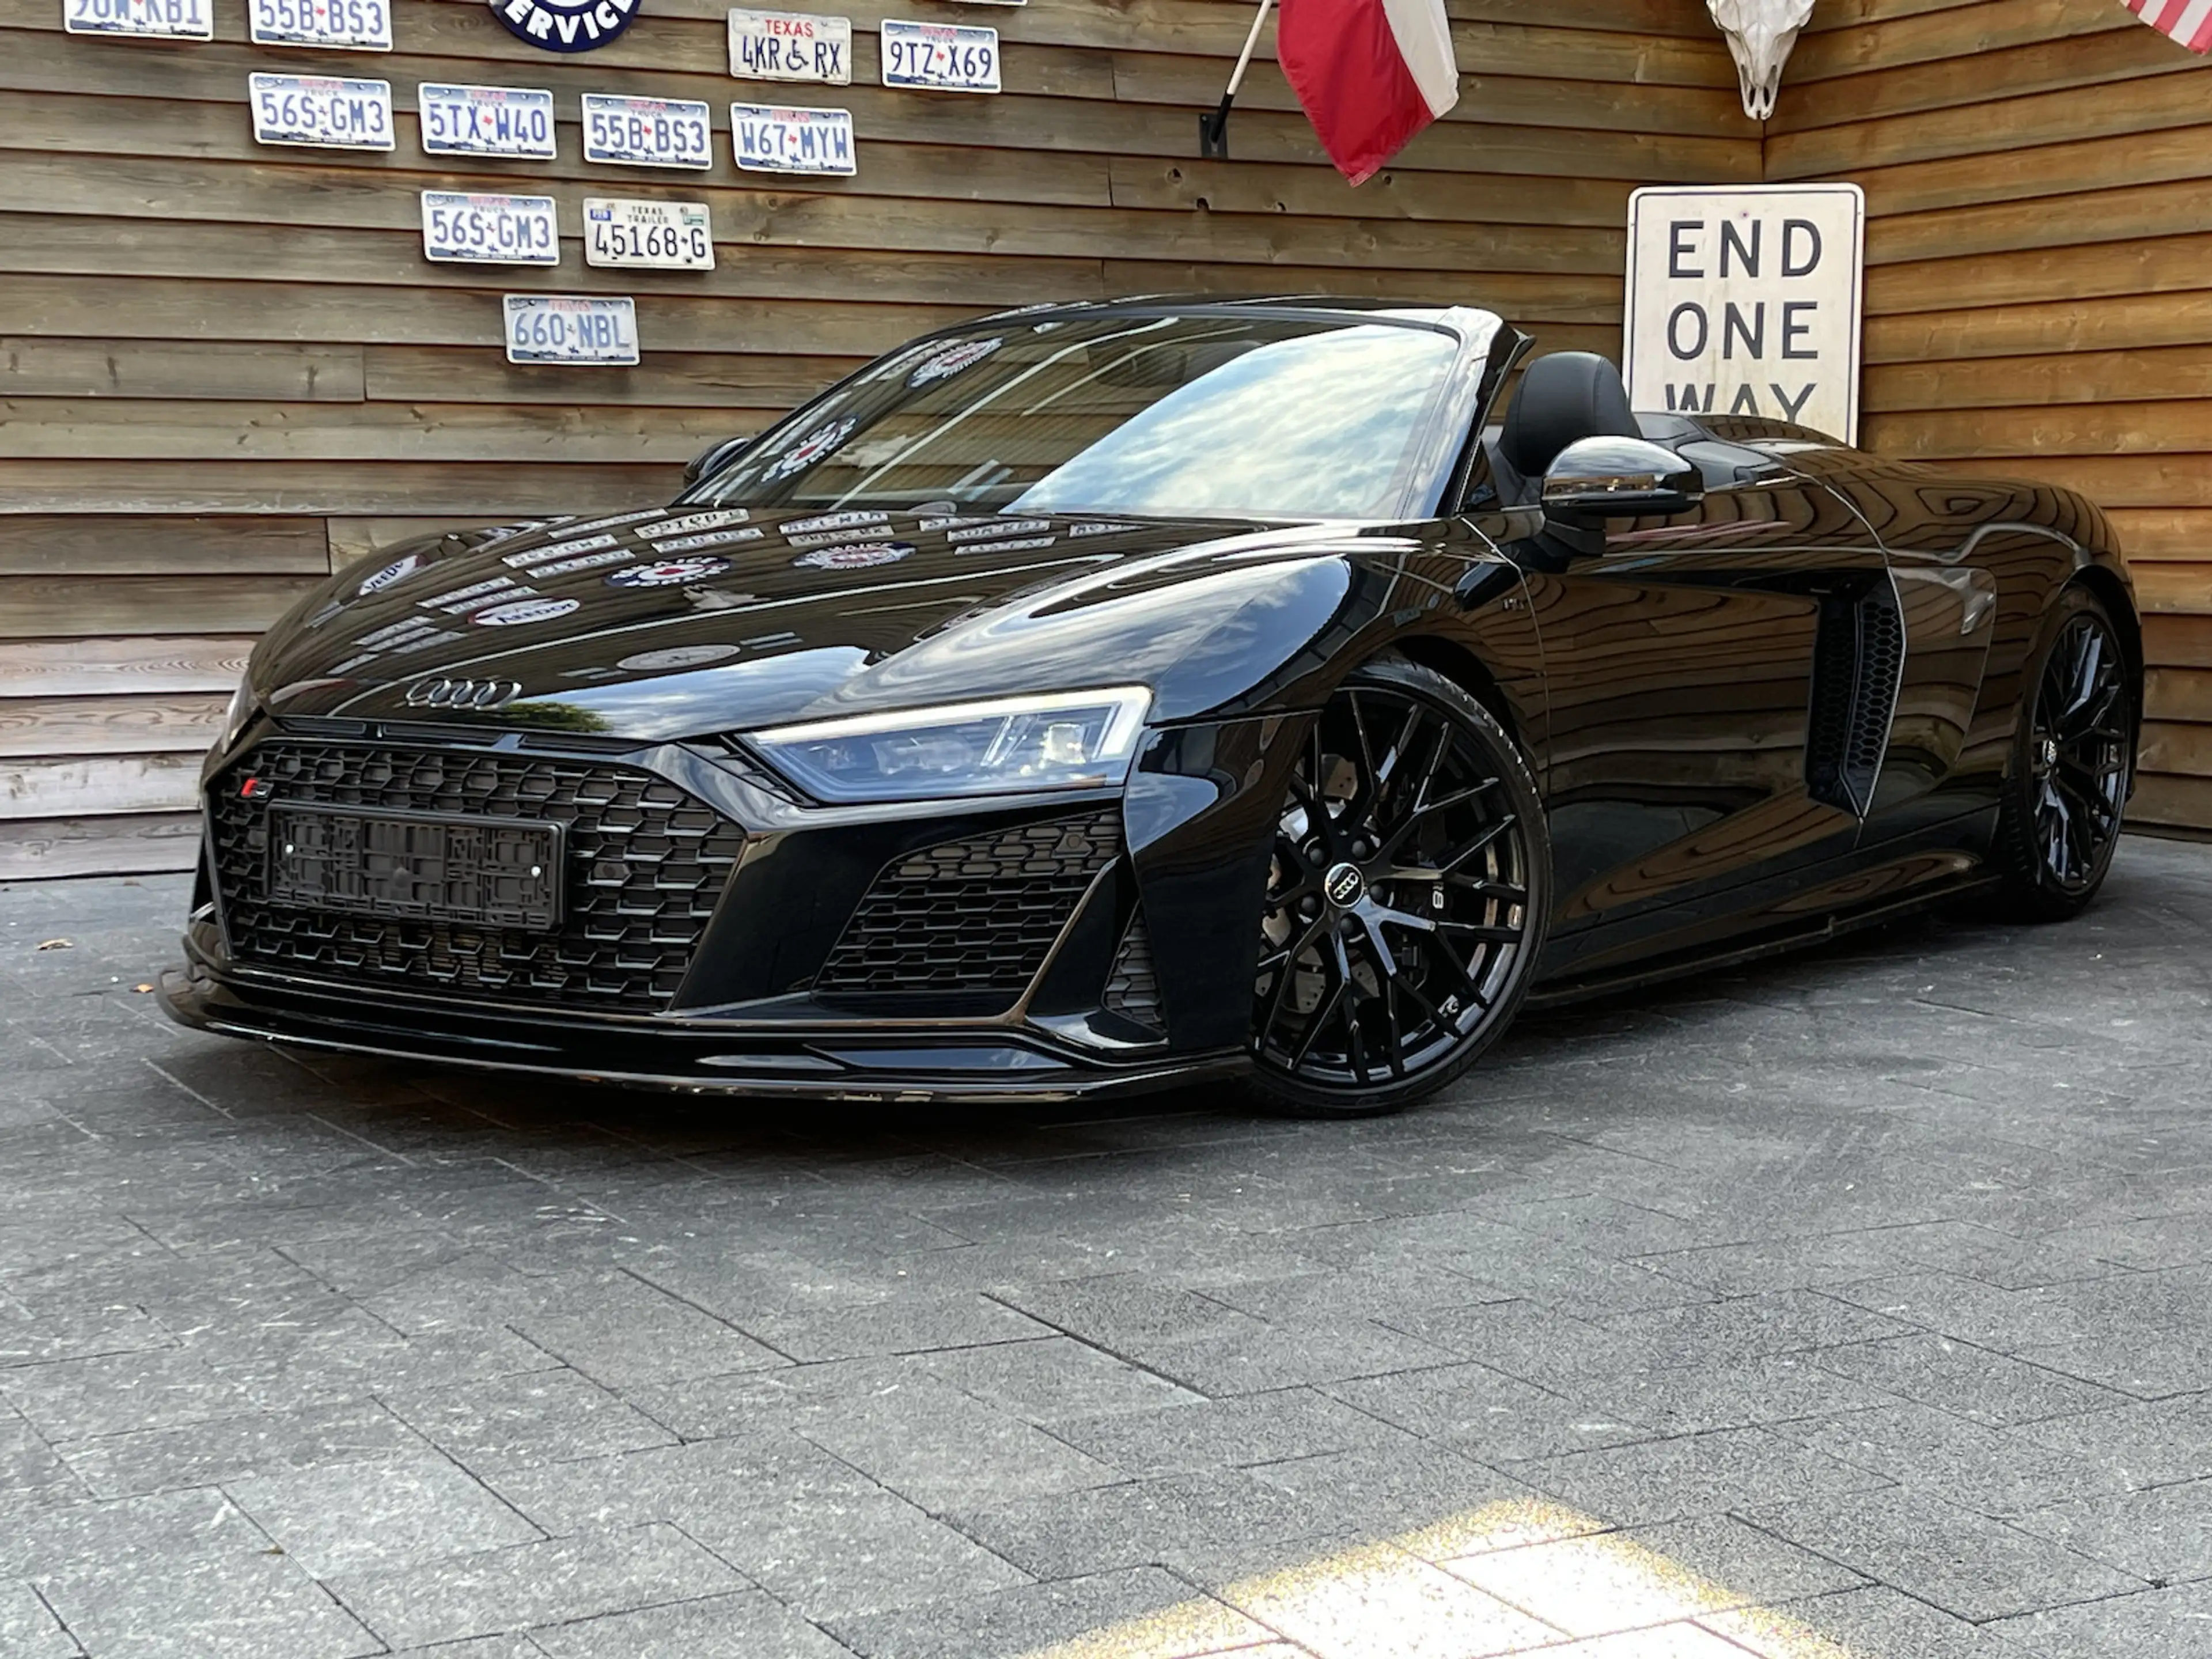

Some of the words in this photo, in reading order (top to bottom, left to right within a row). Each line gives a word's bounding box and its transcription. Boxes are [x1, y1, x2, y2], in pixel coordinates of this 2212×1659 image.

[766, 19, 814, 37] TEXAS
[627, 214, 669, 224] TRAILER
[631, 206, 664, 215] TEXAS
[1668, 219, 1822, 279] END
[1666, 301, 1819, 361] ONE
